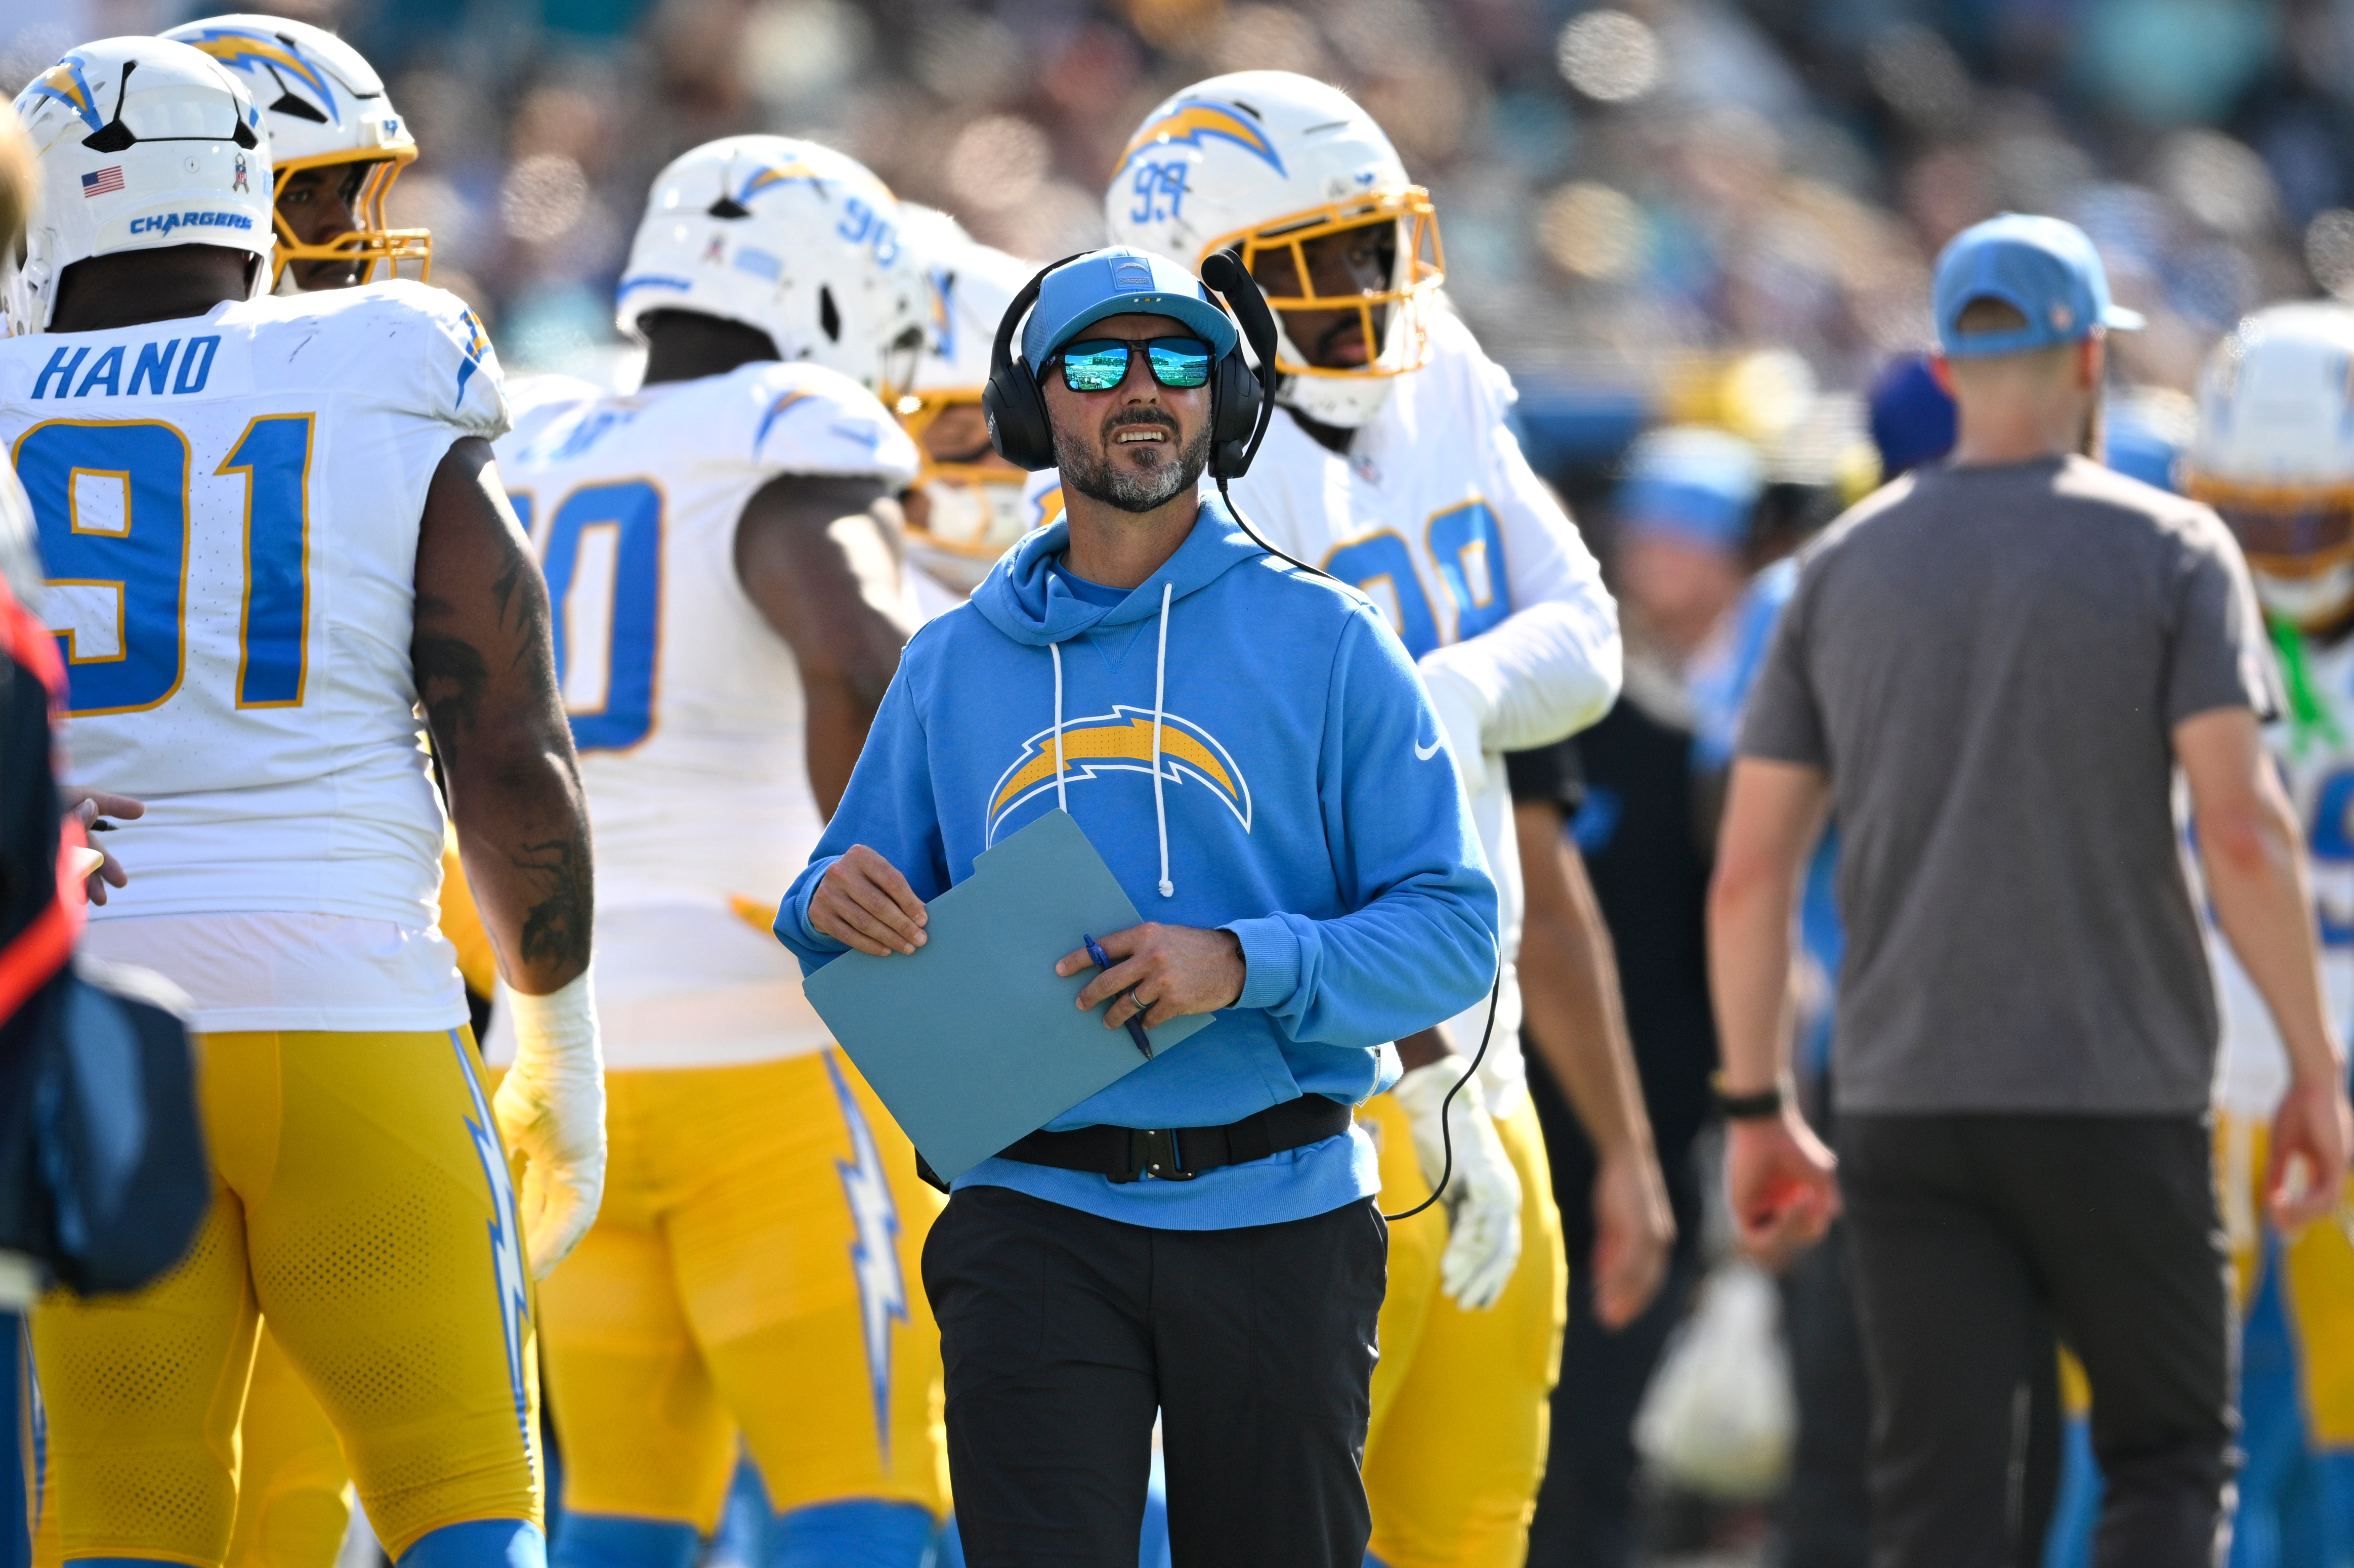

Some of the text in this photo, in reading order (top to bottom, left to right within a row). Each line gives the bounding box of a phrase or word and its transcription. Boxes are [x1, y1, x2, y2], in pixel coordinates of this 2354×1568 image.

[1131, 161, 1187, 223] 99
[130, 211, 254, 238] CHARGERS
[30, 335, 222, 399] HAND
[11, 411, 316, 718] 91
[508, 472, 667, 761] 0
